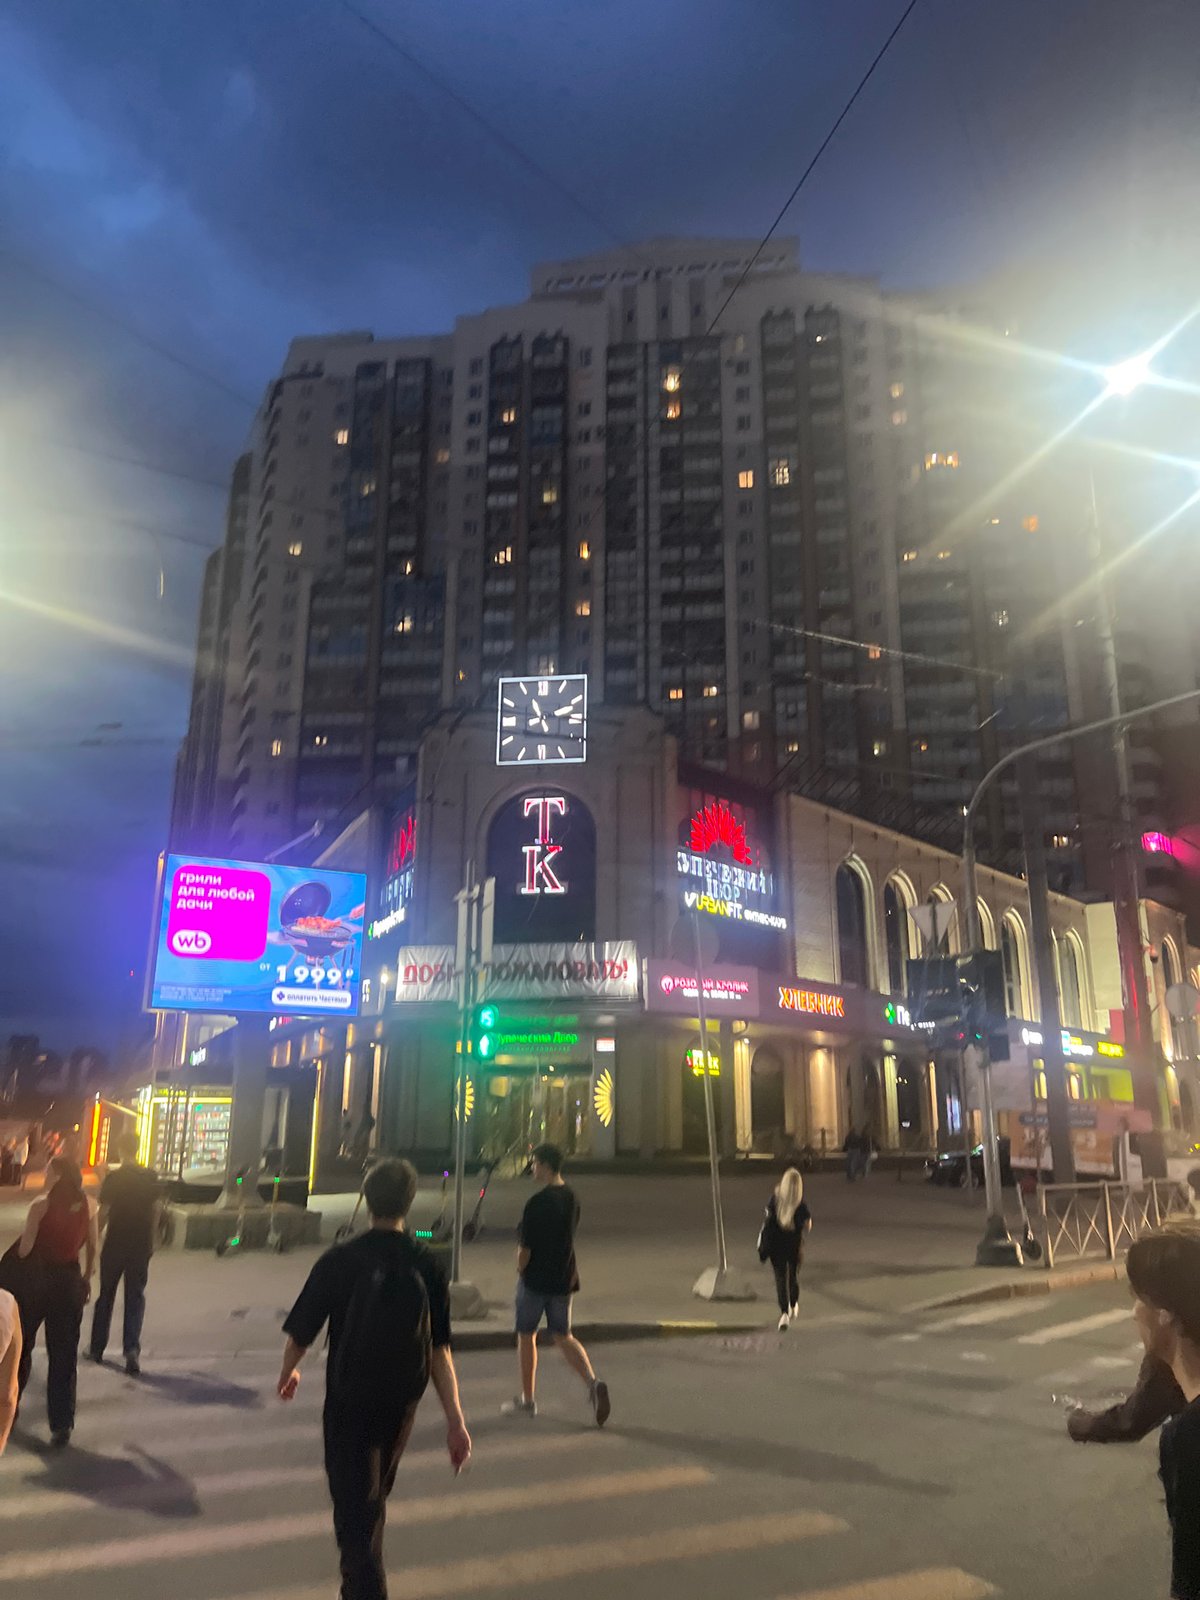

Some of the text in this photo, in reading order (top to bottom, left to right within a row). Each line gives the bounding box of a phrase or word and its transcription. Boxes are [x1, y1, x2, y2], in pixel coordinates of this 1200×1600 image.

[179, 872, 222, 886] грили
[177, 885, 256, 902] для любой
[176, 897, 214, 911] дачи
[177, 931, 207, 949] wb
[778, 986, 845, 1017] ХЛЕБНИК
